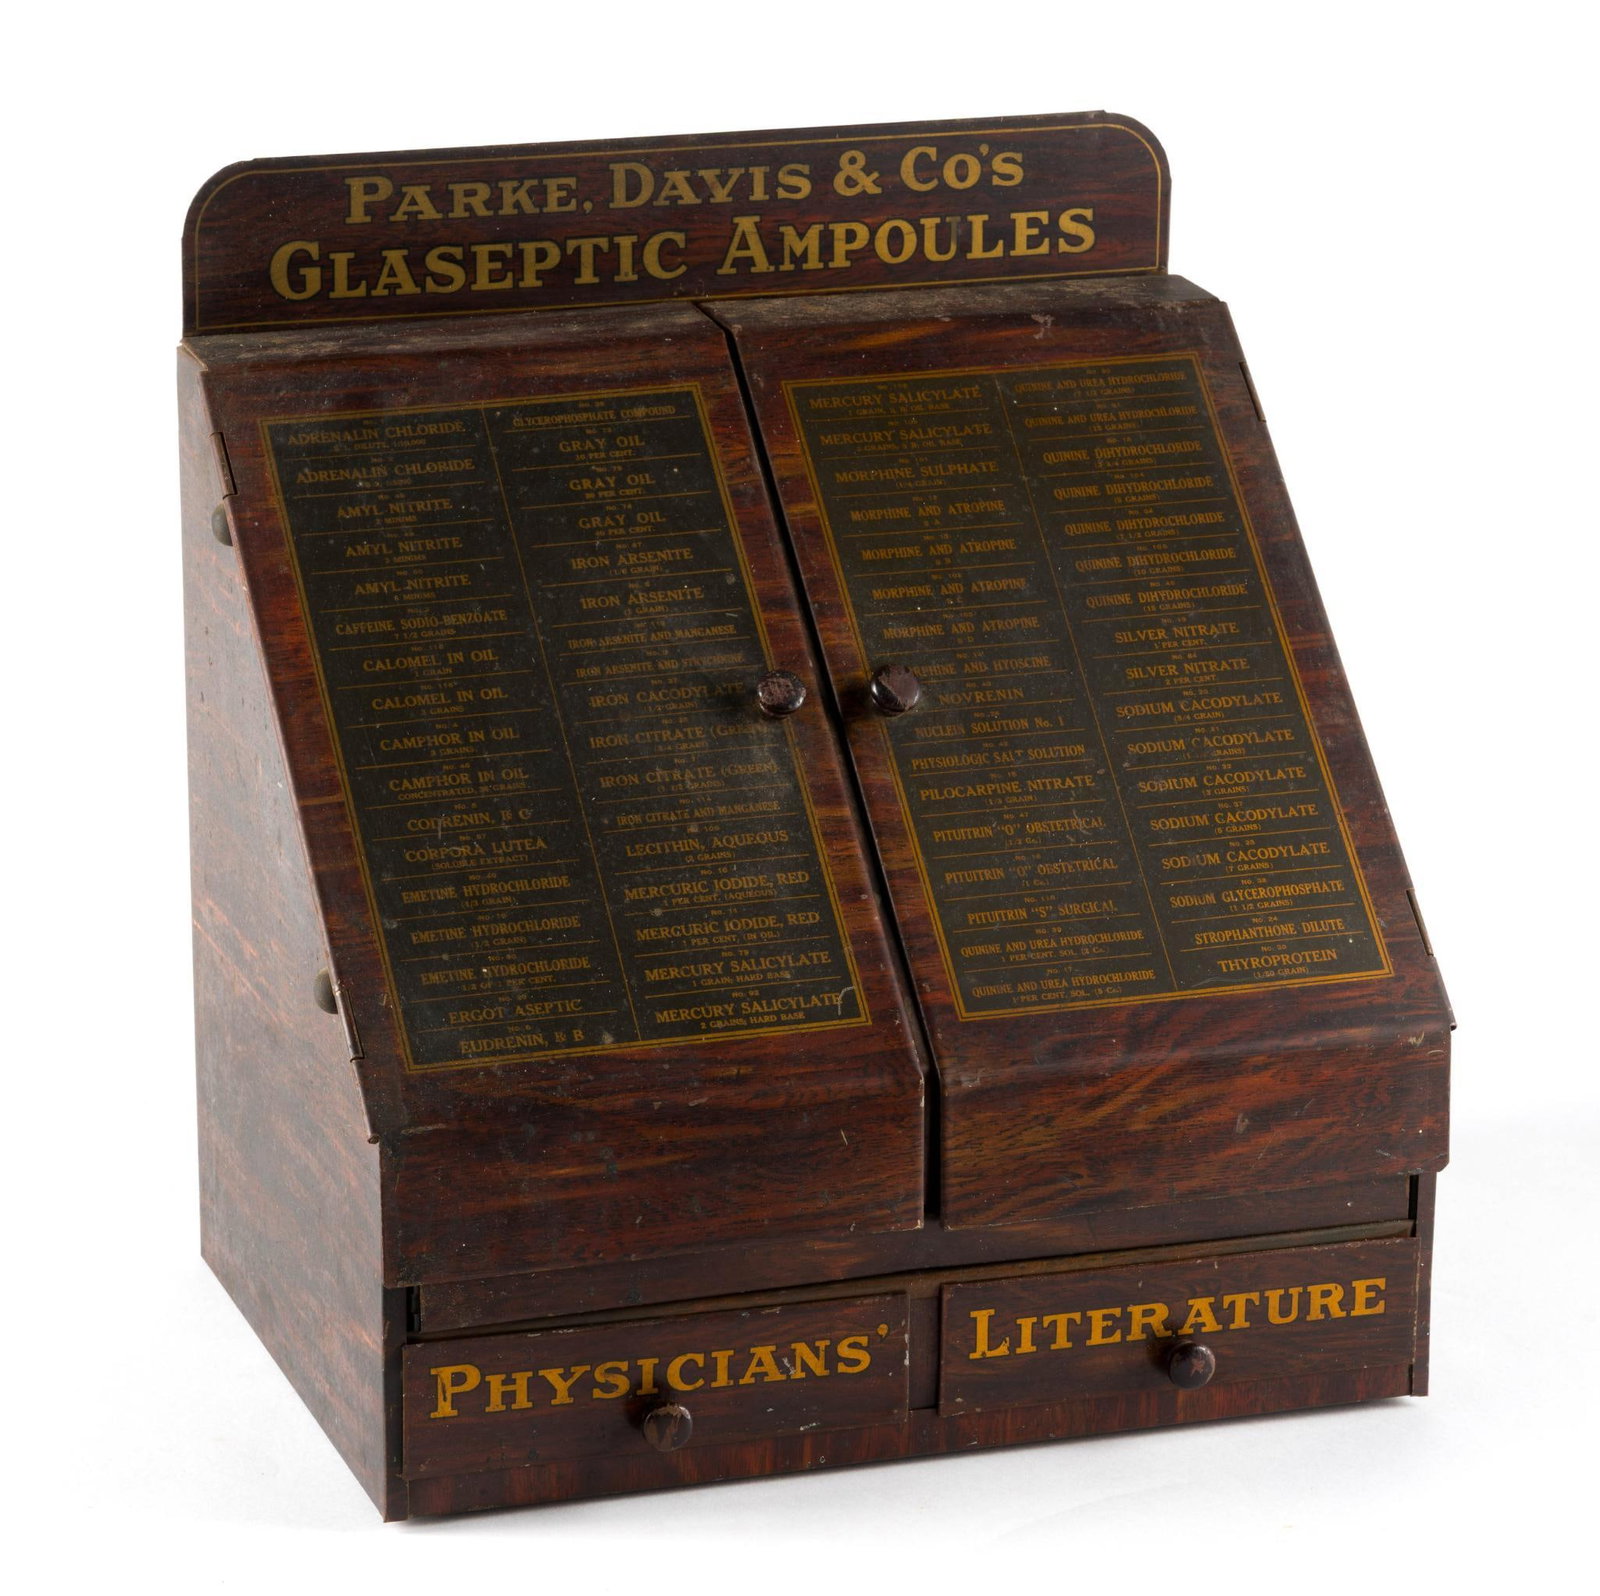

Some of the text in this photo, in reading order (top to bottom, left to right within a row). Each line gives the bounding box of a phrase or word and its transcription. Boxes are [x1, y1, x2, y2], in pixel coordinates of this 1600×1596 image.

[832, 149, 882, 196] &
[558, 434, 645, 453] GRAY OIL
[819, 429, 894, 446] MERCURY
[898, 422, 993, 440] SALICYLATE
[294, 464, 388, 484] ADRENALIN
[392, 457, 476, 476] CHLORIDE
[568, 472, 656, 491] GRAY OIL
[834, 460, 999, 483] MORPHINE SULPHATE
[1053, 476, 1214, 500] QUININE DIHYDROCHLORIDE
[335, 497, 453, 519] AMYL NITRITE
[577, 510, 666, 529] GRAY OIL
[1063, 511, 1225, 536] QUININE DIHYDROCHLORIDE
[344, 536, 463, 557] AMYL NITRITE
[569, 547, 694, 570] IRON ARSENITE
[860, 545, 922, 561] MORPHINE
[927, 543, 953, 556] AND
[957, 537, 1017, 553] ATROPINE
[1074, 556, 1123, 572] QUININE
[1125, 547, 1237, 568] DIHYDROCHLORIDE
[353, 573, 471, 595] AMYL NITRITE
[871, 584, 933, 601] MORPHINE
[938, 582, 965, 595] AND
[969, 576, 1028, 592] ATROPINE
[1085, 583, 1248, 609] QUININE DIHYDROCHLORIDE
[579, 587, 705, 610] IRON ARSENITE
[334, 619, 395, 636] CAFFEINE
[1113, 622, 1239, 644] SILVER NITRATE
[361, 648, 499, 672] CALOMEL IN OIL
[962, 660, 988, 673] AND
[991, 654, 1051, 671] HYOSCINE
[1124, 657, 1250, 680] SILVER NITRATE
[370, 686, 508, 710] CALOMEL IN OIL
[589, 693, 629, 708] IRON
[937, 687, 1025, 706] NOVRENIN
[1114, 691, 1283, 718] SODIUM CACODYLATE
[379, 726, 520, 752] CAMPHOR IN OIL
[913, 723, 966, 739] NUCLEIN
[968, 718, 1030, 734] SOLUTION
[1056, 714, 1065, 726] 1
[910, 752, 990, 771] PHYSIOLOGIC
[1026, 743, 1087, 760] SOLUTION
[1126, 738, 1186, 755] SODIUM
[388, 766, 529, 791] CAMPHOR IN OIL
[598, 773, 640, 789] IRON
[644, 765, 716, 785] CITRATE
[918, 773, 1095, 801] PILOCARPINE NITRATE
[1137, 766, 1307, 793] SODIUM CACODYLATE
[1149, 803, 1319, 831] SODIUM CACODYLATE
[624, 829, 789, 858] LECITHIN, AQUEOUS
[932, 825, 993, 843] PITUITRIN
[404, 836, 547, 863] CORPORA LUTEA
[1225, 841, 1331, 863] CACODYLATE
[944, 867, 1005, 885] PITUITRIN
[1036, 856, 1118, 875] OBSTETRICAL
[401, 875, 571, 904] EMETINE HYDROCHLORIDE
[623, 869, 811, 902] MERCURIC IODIDE, RED
[1168, 879, 1345, 909] SODIUM GLYCEROPHOSPHATE
[966, 907, 1028, 925] PITUITRIN
[1056, 898, 1117, 916] SURGICAL
[410, 914, 581, 944] EMETINE HYDROCHLORIDE
[634, 910, 821, 942] MERCURIC IODIDE, RED
[1193, 918, 1345, 945] STROPHANTHONE DILUTE
[959, 929, 1145, 958] QUININE AND UREA HYDROCHLORIDE
[643, 950, 831, 982] MERCURY SALICYLATE
[1216, 948, 1338, 972] THYROPROTEIN
[970, 968, 1156, 998] QUININE AND UREA HYDROCHLORIDE
[447, 998, 582, 1024] ERGOT ASEPTIC
[654, 991, 842, 1024] MERCURY SALICYLATE
[750, 1014, 777, 1024] HARD
[779, 1011, 805, 1021] BASE
